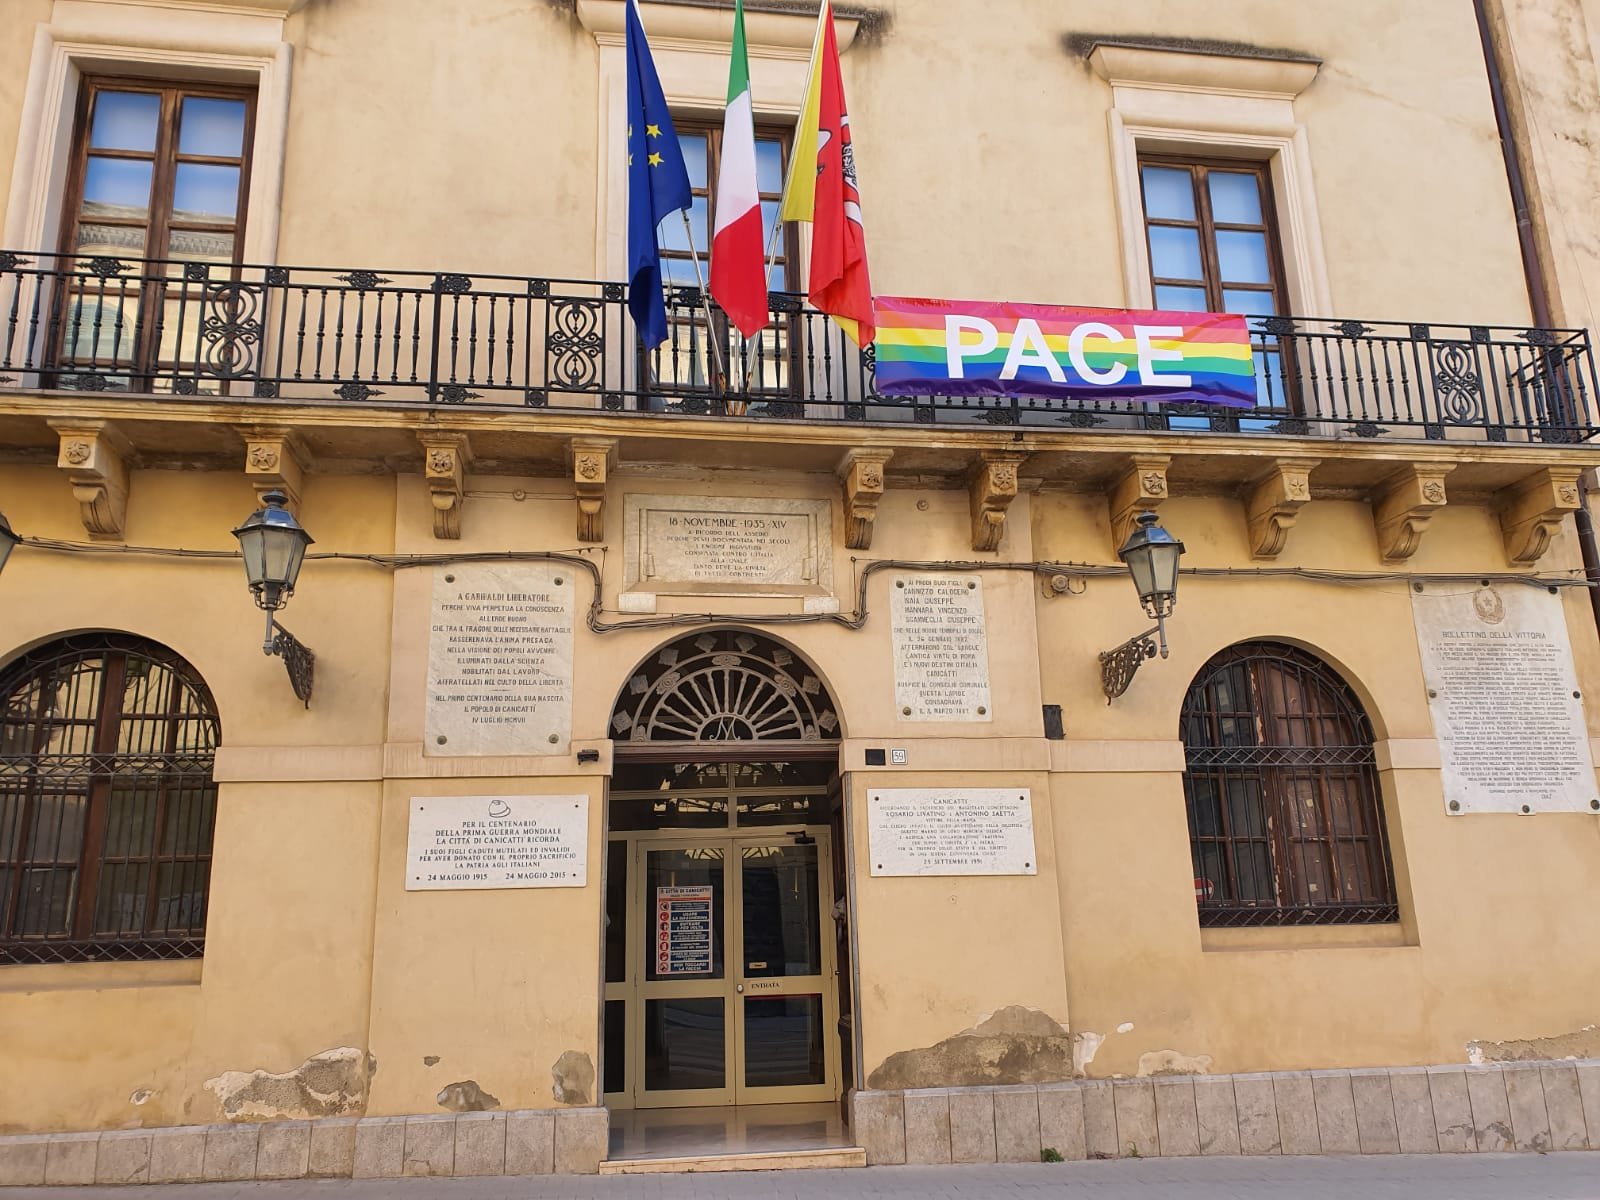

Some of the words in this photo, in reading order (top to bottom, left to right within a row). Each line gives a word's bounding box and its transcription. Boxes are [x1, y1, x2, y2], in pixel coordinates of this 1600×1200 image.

[944, 314, 1192, 387] PACE
[669, 517, 678, 526] 18
[683, 517, 737, 528] NOVEMBRE
[744, 520, 765, 529] 1935
[772, 520, 787, 529] XIV
[458, 593, 463, 601] A
[465, 593, 504, 601] GARIBALDI
[506, 593, 550, 602] LIBERATORE
[924, 597, 954, 605] GIUSEPPE
[947, 616, 976, 624] GIUSEPPE
[1442, 631, 1487, 639] BOLLETTINO
[1489, 631, 1513, 639] DELLA
[488, 820, 537, 828] CENTENARIO
[550, 871, 566, 879] 2015
